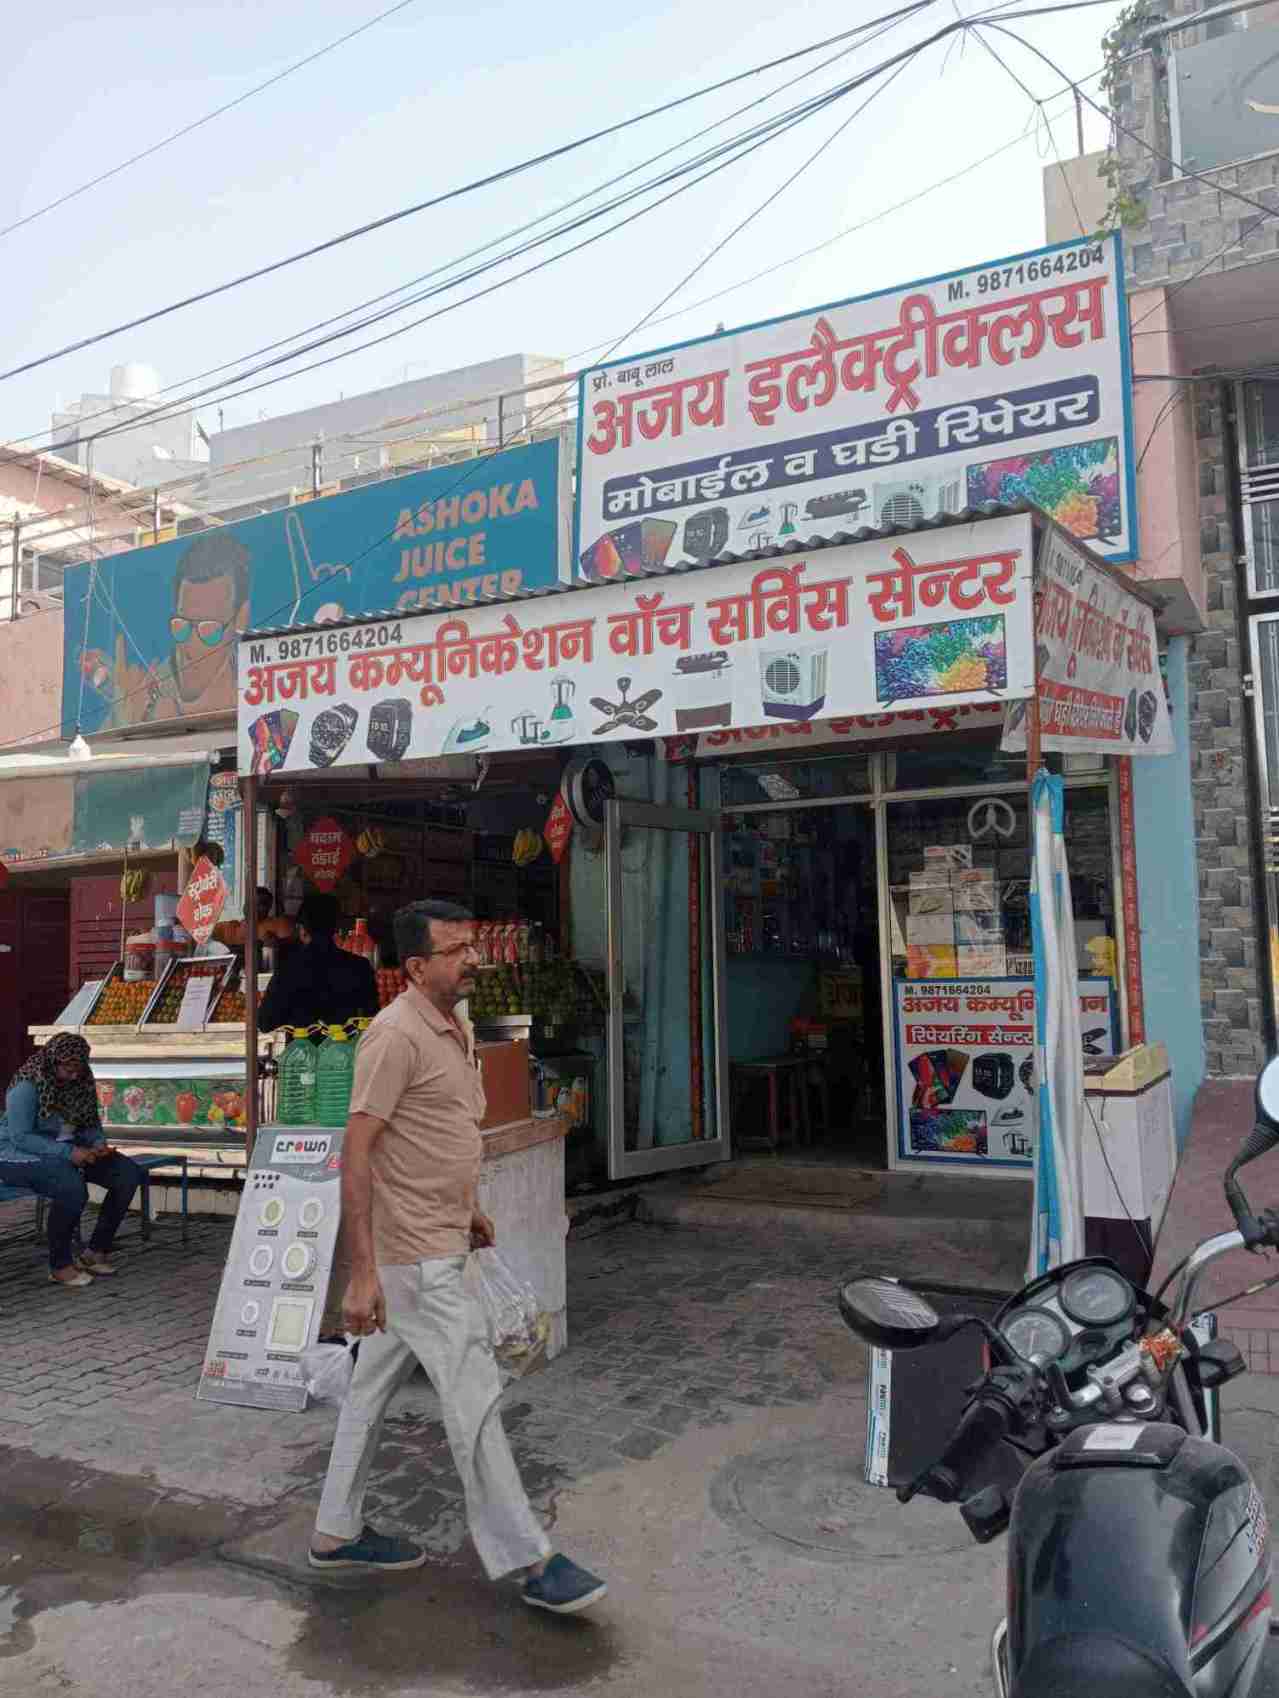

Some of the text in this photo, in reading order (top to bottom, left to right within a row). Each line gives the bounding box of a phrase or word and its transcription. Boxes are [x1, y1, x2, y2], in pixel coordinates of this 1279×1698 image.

[948, 245, 1105, 302] M. 9871664204
[617, 366, 643, 387] बाबू
[645, 358, 674, 379] लाल
[586, 369, 729, 455] अजय
[606, 455, 773, 514] मोबाईल
[783, 446, 817, 477] व
[934, 391, 1094, 448] रिपेयर
[391, 479, 539, 542] ASHOKA
[393, 532, 485, 583] JUICE
[244, 655, 338, 706] अजय
[348, 613, 596, 706] कम्यूनिकेशन
[607, 592, 695, 656] वॉच
[706, 561, 854, 645] सर्विस
[865, 546, 1022, 622] सेन्टर
[250, 623, 402, 664] M. 9871664204
[902, 997, 961, 1013] अजय
[911, 1025, 981, 1043] रिपेयरिंग
